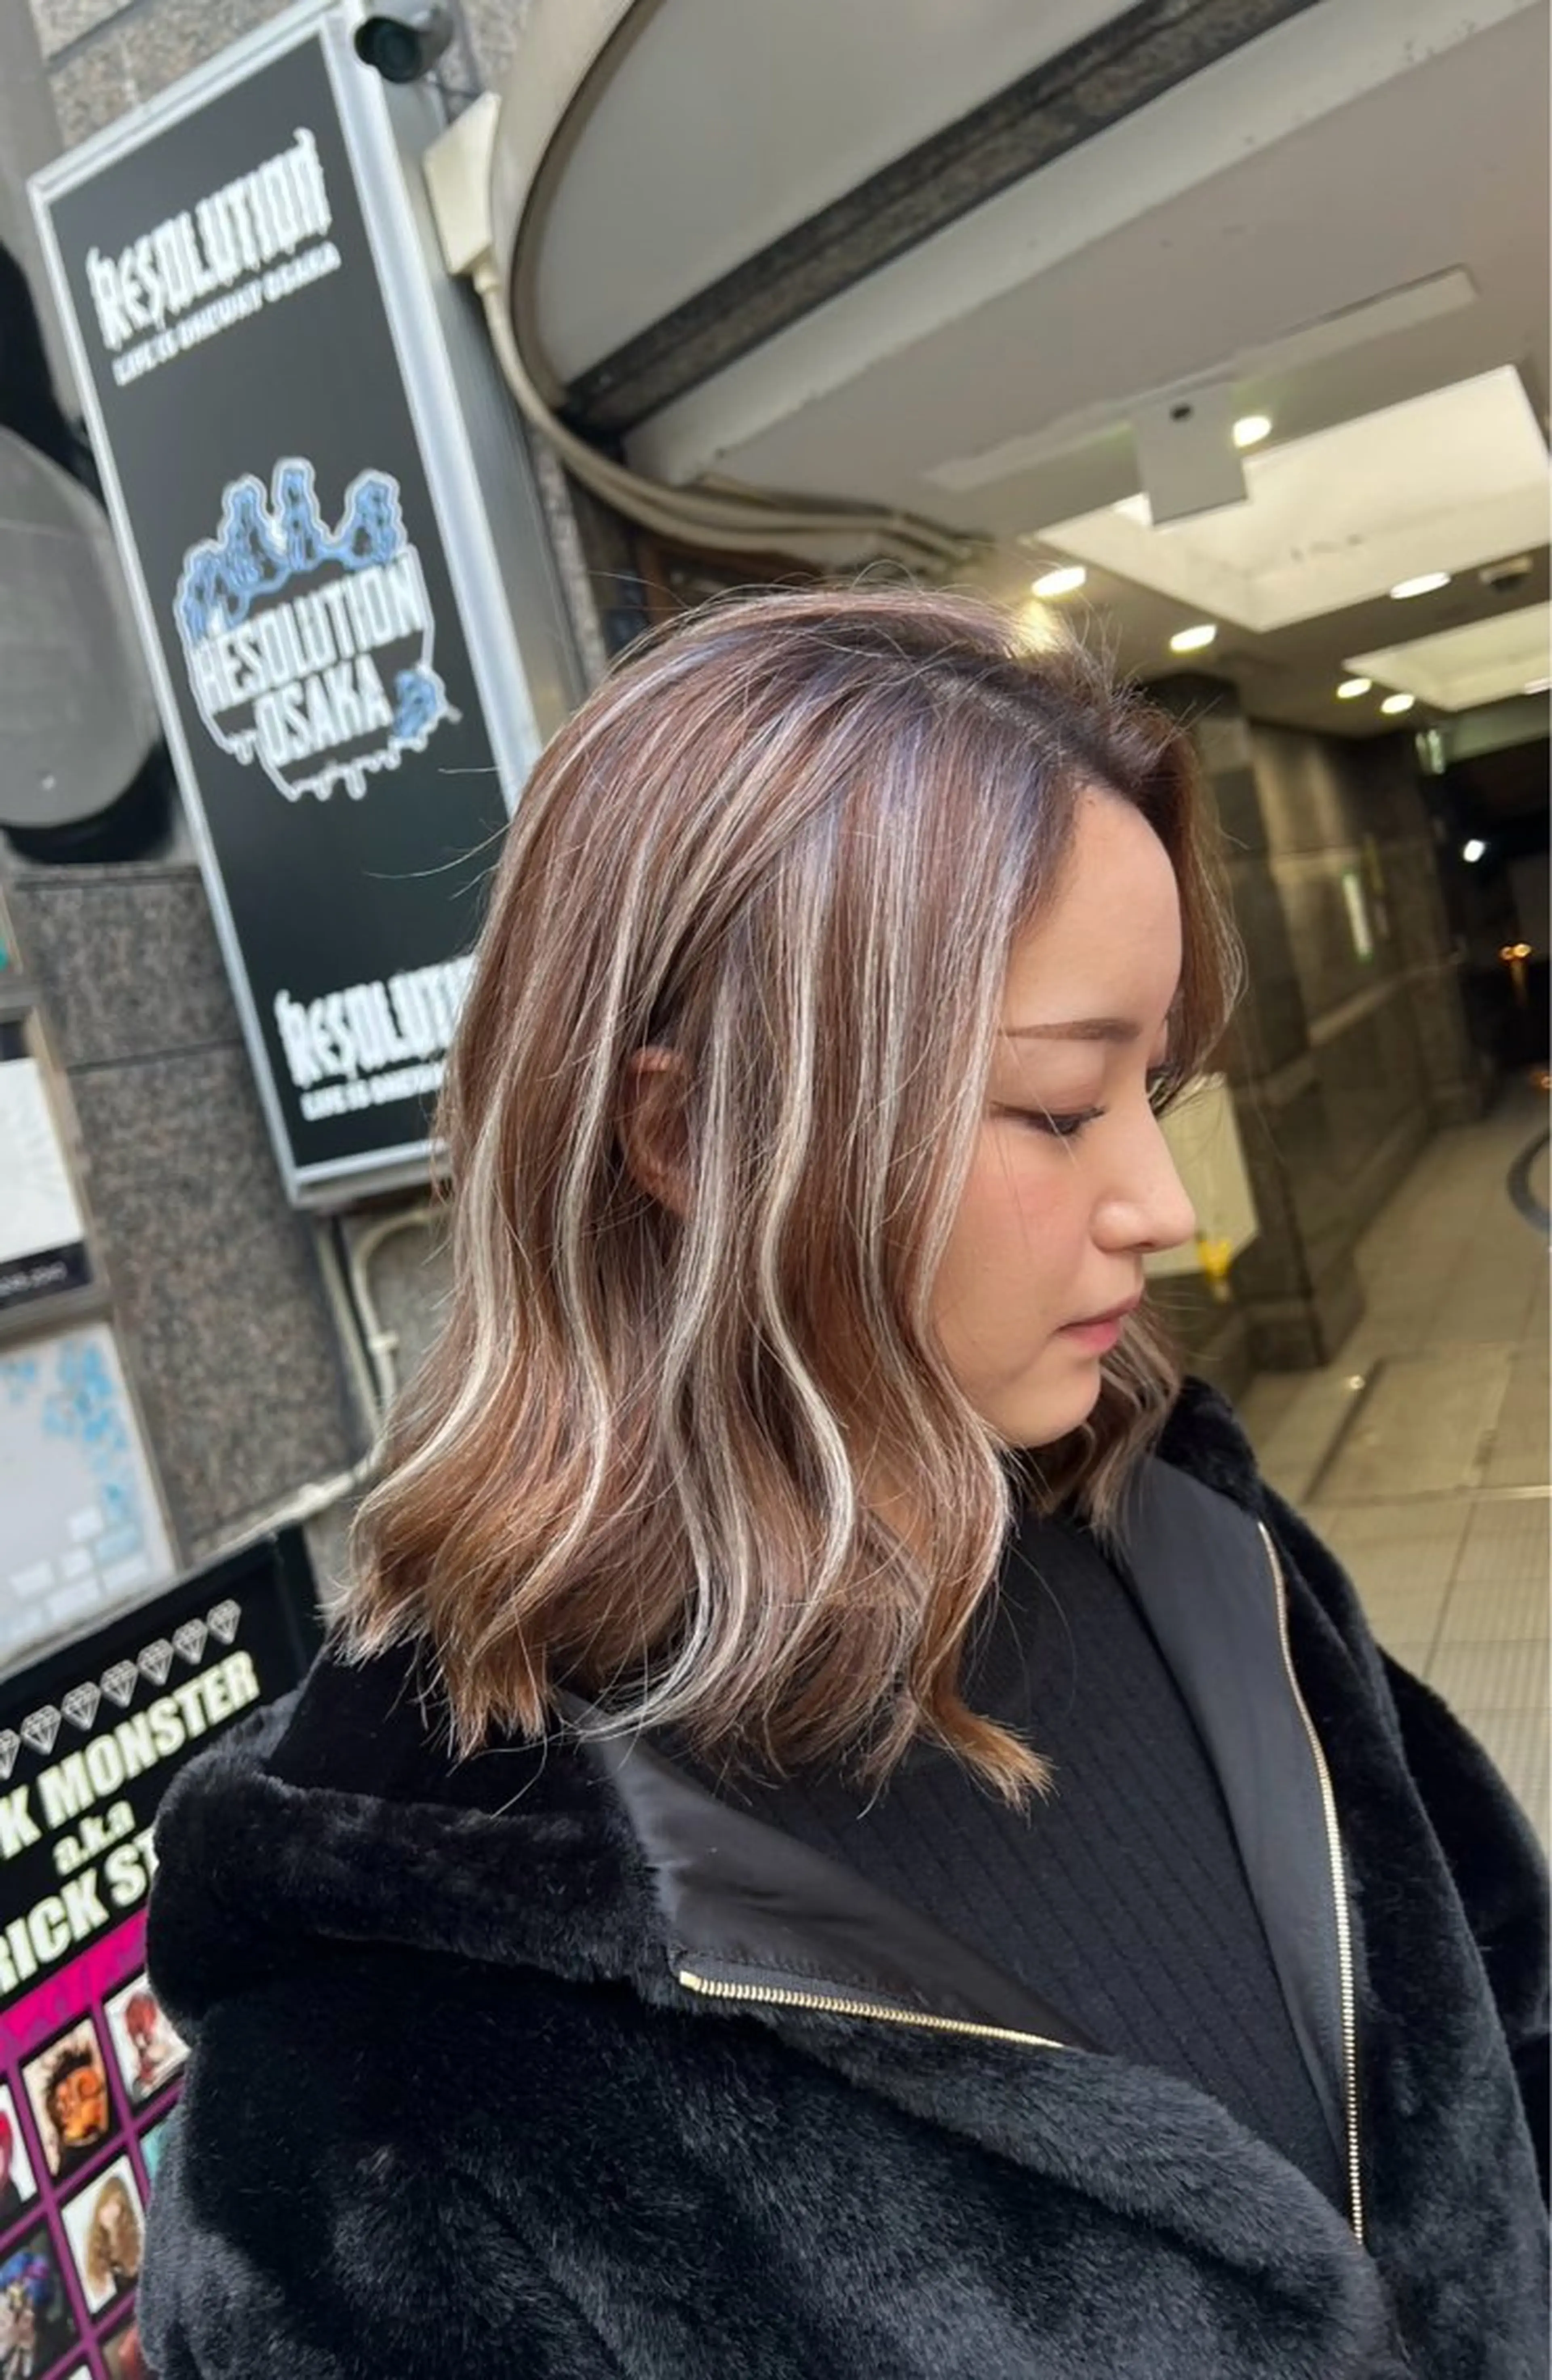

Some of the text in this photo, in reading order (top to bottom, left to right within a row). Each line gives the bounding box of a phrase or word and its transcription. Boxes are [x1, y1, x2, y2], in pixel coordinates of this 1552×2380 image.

[195, 550, 426, 715] RESOLUTION
[254, 652, 394, 767] OSAKA
[38, 1651, 260, 1829] MONSTER
